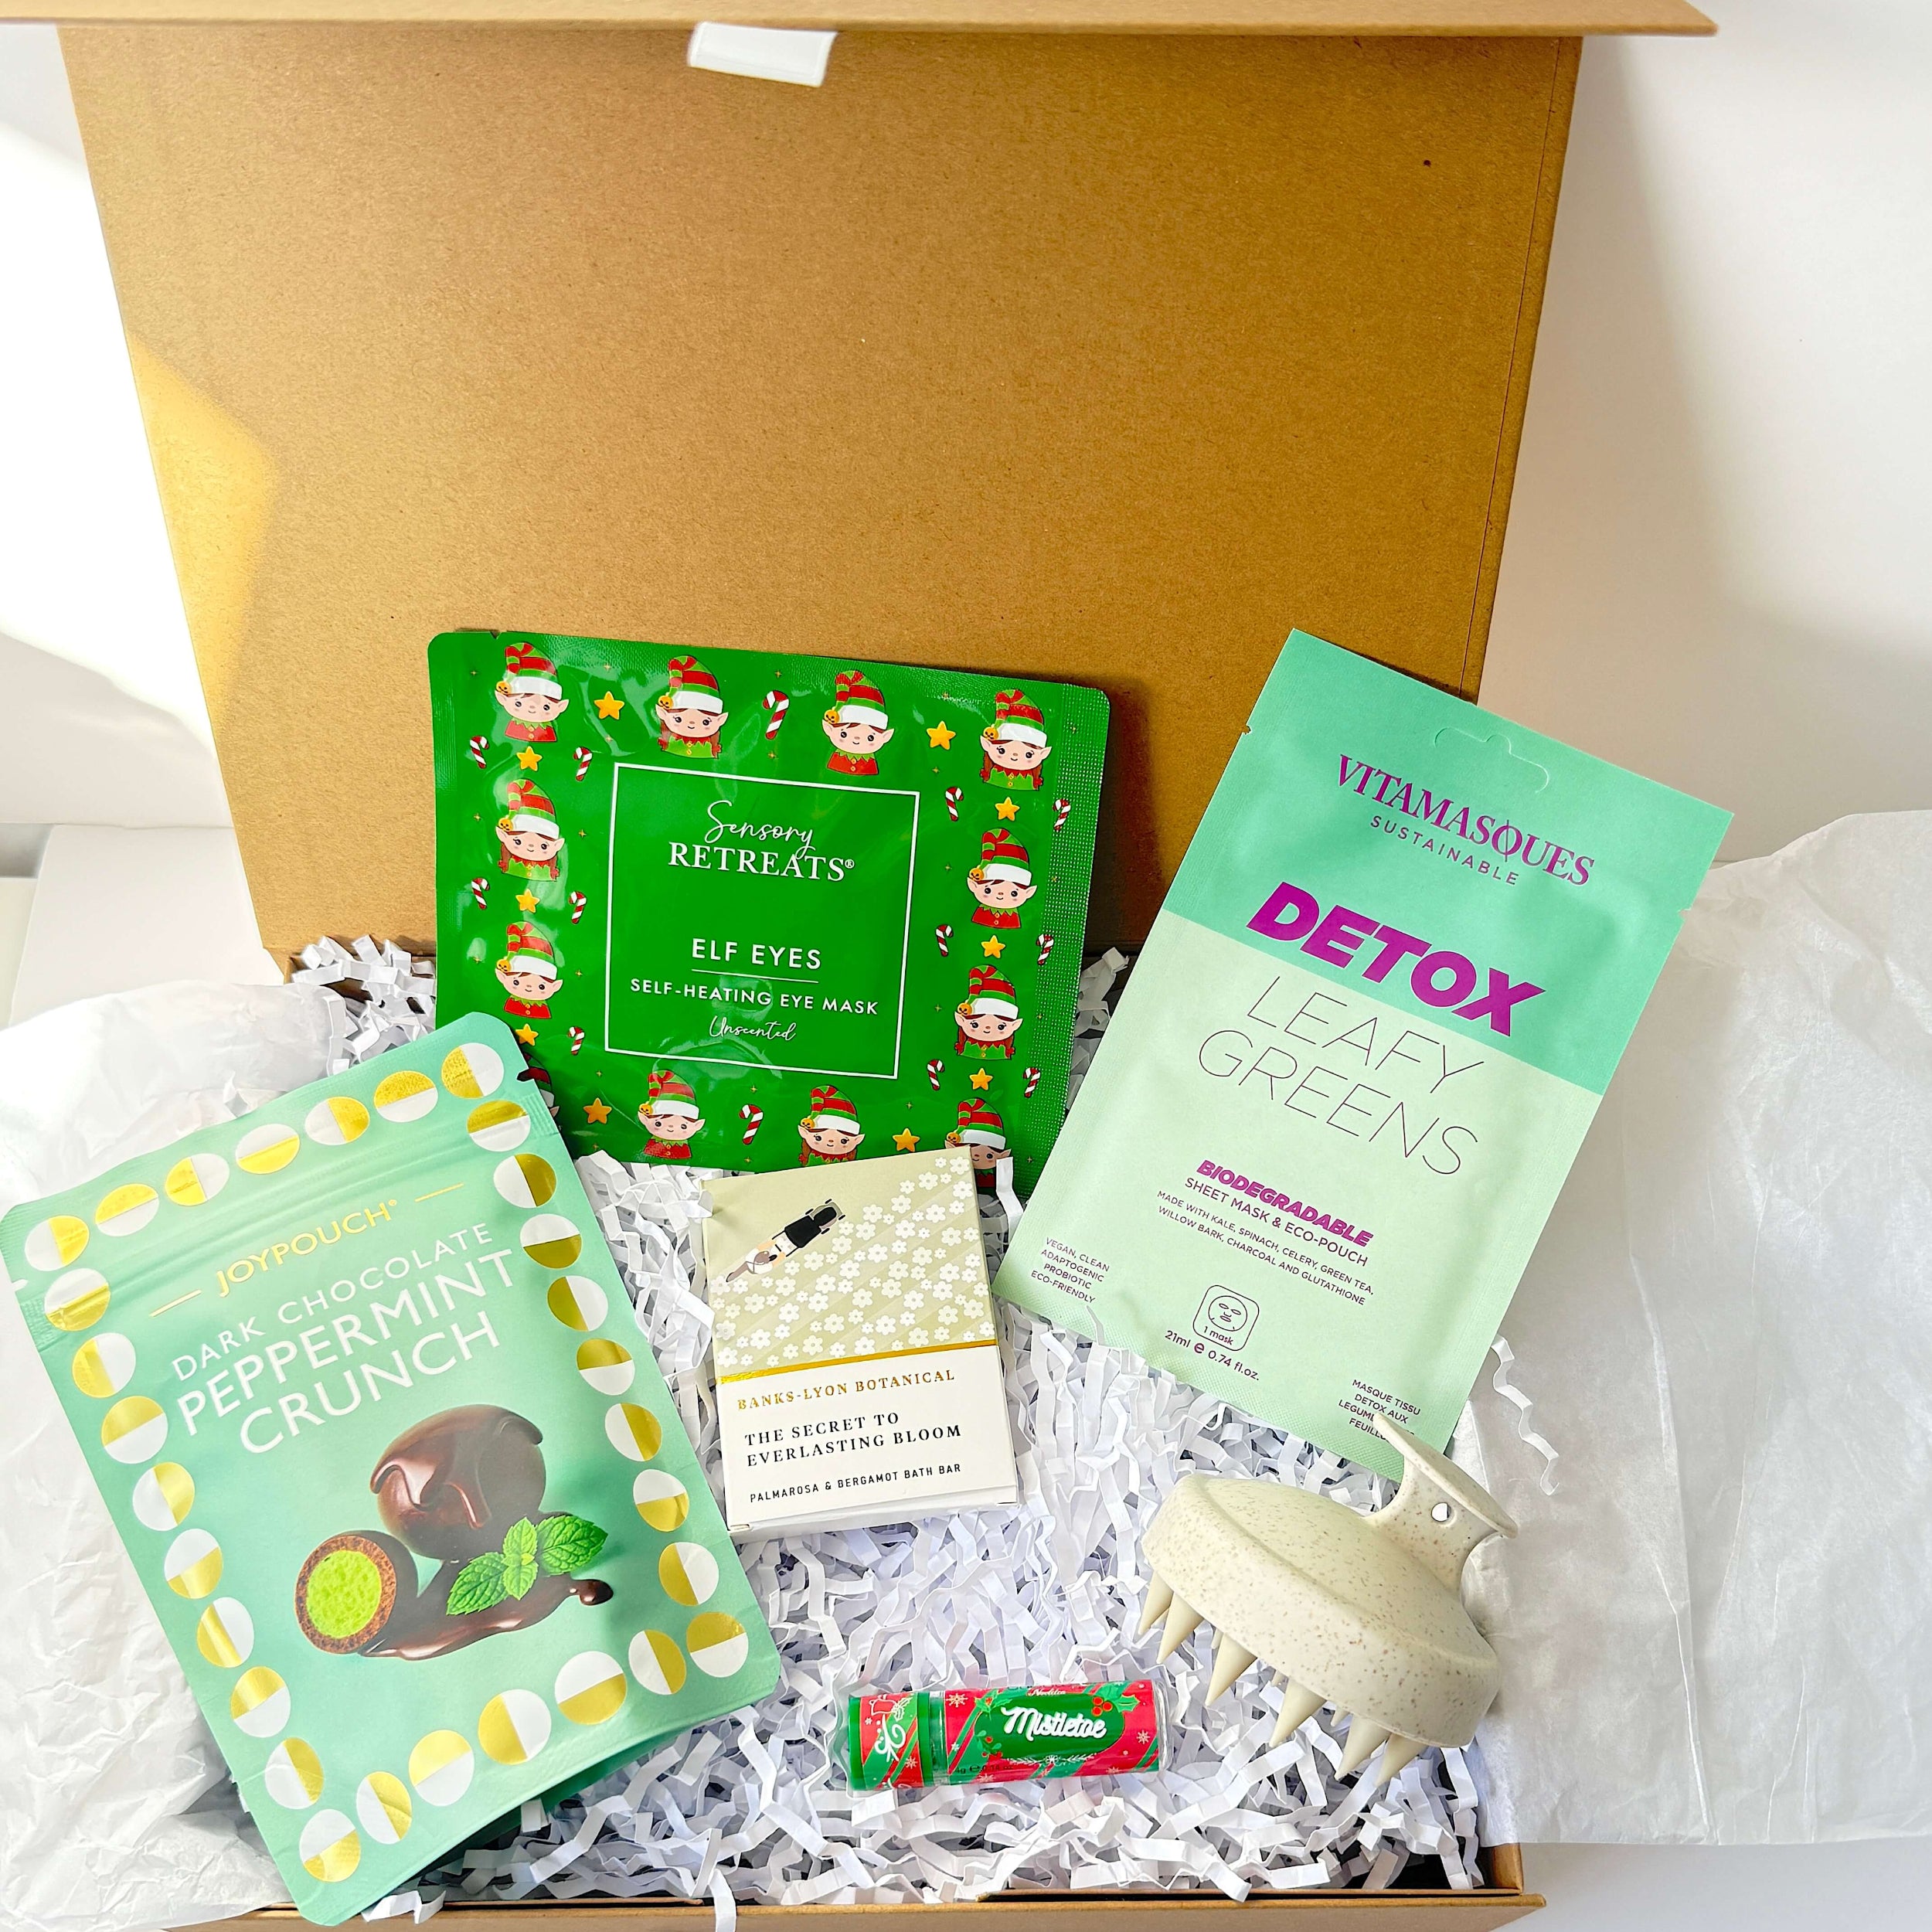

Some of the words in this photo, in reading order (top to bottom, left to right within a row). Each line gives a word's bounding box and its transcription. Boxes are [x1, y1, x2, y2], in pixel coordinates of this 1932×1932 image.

[705, 800, 816, 859] Sensory
[1338, 754, 1595, 886] VITAMASQUES
[1370, 815, 1519, 886] SUSTAINABLE
[692, 938, 738, 962] ELF
[751, 944, 822, 970] EYES
[1246, 882, 1546, 1037] DETOX
[630, 978, 772, 1006] SELF-HEATING
[781, 995, 814, 1010] EYE
[822, 998, 879, 1015] MASK
[709, 1015, 797, 1042] Unscented
[1247, 976, 1485, 1094] LEAFY
[1199, 1030, 1478, 1175] GREENS
[1185, 1177, 1230, 1203] SHEET
[1230, 1198, 1270, 1223] MASK
[1272, 1217, 1282, 1228] &
[1284, 1223, 1369, 1267] ECO-POUCH
[1196, 1160, 1374, 1247] BIODEGRADABLE
[1046, 1236, 1077, 1258] VEGAN,
[1079, 1253, 1110, 1271] CLEAN
[1157, 1190, 1183, 1207] MADE
[1186, 1204, 1210, 1219] WITH
[1211, 1214, 1236, 1233] KALE,
[1239, 1227, 1279, 1252] SPINACH,
[1282, 1247, 1318, 1270] CELERY,
[1320, 1264, 1352, 1284] GREEN
[1355, 1280, 1374, 1294] TEA,
[1159, 1206, 1197, 1227] WILLOW
[1198, 1224, 1223, 1242] BARK,
[1227, 1237, 1276, 1265] CHARCOAL
[1278, 1261, 1299, 1275] AND
[1301, 1271, 1366, 1305] GLUTATHIONE
[1031, 1270, 1095, 1303] ECO-FRIENDLY
[1041, 1249, 1104, 1282] ADAPTOGENIC
[1043, 1263, 1092, 1289] PROBIOTIC
[172, 1316, 266, 1381] DARK
[277, 1223, 494, 1324] CHOCOLATE
[176, 1249, 513, 1436] PEPPERMINT
[1165, 1330, 1191, 1348] 21ml
[1208, 1350, 1232, 1366] 0.74
[1234, 1362, 1259, 1380] fl.oz.
[1209, 1330, 1234, 1345] mask
[240, 1311, 500, 1454] CRUNCH
[737, 1383, 848, 1410] BANKS-LYON
[855, 1369, 955, 1392] BOTANICAL
[1352, 1379, 1393, 1403] MASQUE
[1395, 1398, 1421, 1415] TISSU
[744, 1430, 784, 1446] THE
[791, 1416, 866, 1438] SECRET
[873, 1412, 900, 1427] TO
[1355, 1393, 1387, 1413] DETOX
[1387, 1410, 1408, 1423] AUX
[747, 1434, 884, 1467] EVERLASTING
[893, 1424, 961, 1445] BLOOM
[750, 1483, 819, 1502] PALMAROSA
[825, 1481, 832, 1490] &
[838, 1471, 899, 1488] BERGAMOT
[904, 1467, 933, 1478] BATH
[939, 1464, 961, 1474] BAR
[1000, 1706, 1108, 1742] Mistletoe
